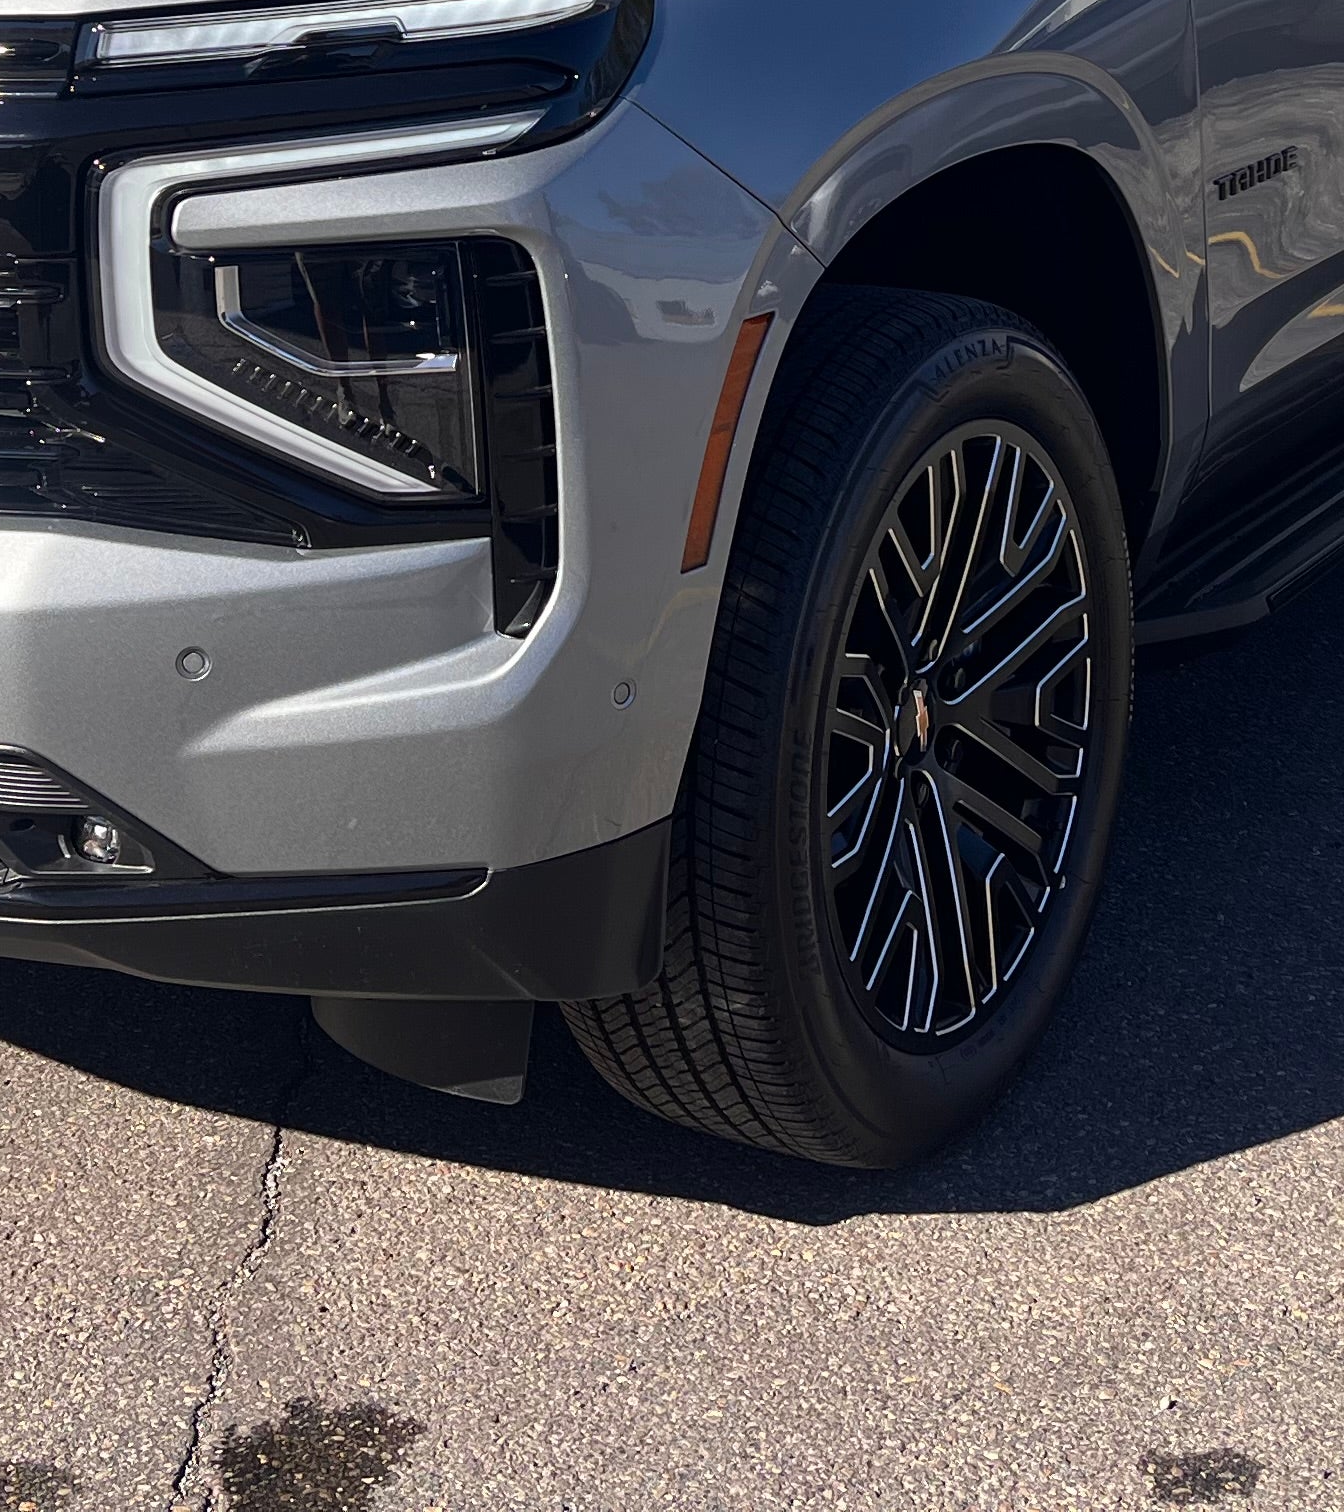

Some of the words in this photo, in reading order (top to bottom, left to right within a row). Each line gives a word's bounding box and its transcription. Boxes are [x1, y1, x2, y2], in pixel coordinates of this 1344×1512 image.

[1213, 145, 1298, 201] TAHOE
[933, 338, 1000, 381] ALENZA
[788, 728, 821, 981] BRIDGESTONE
